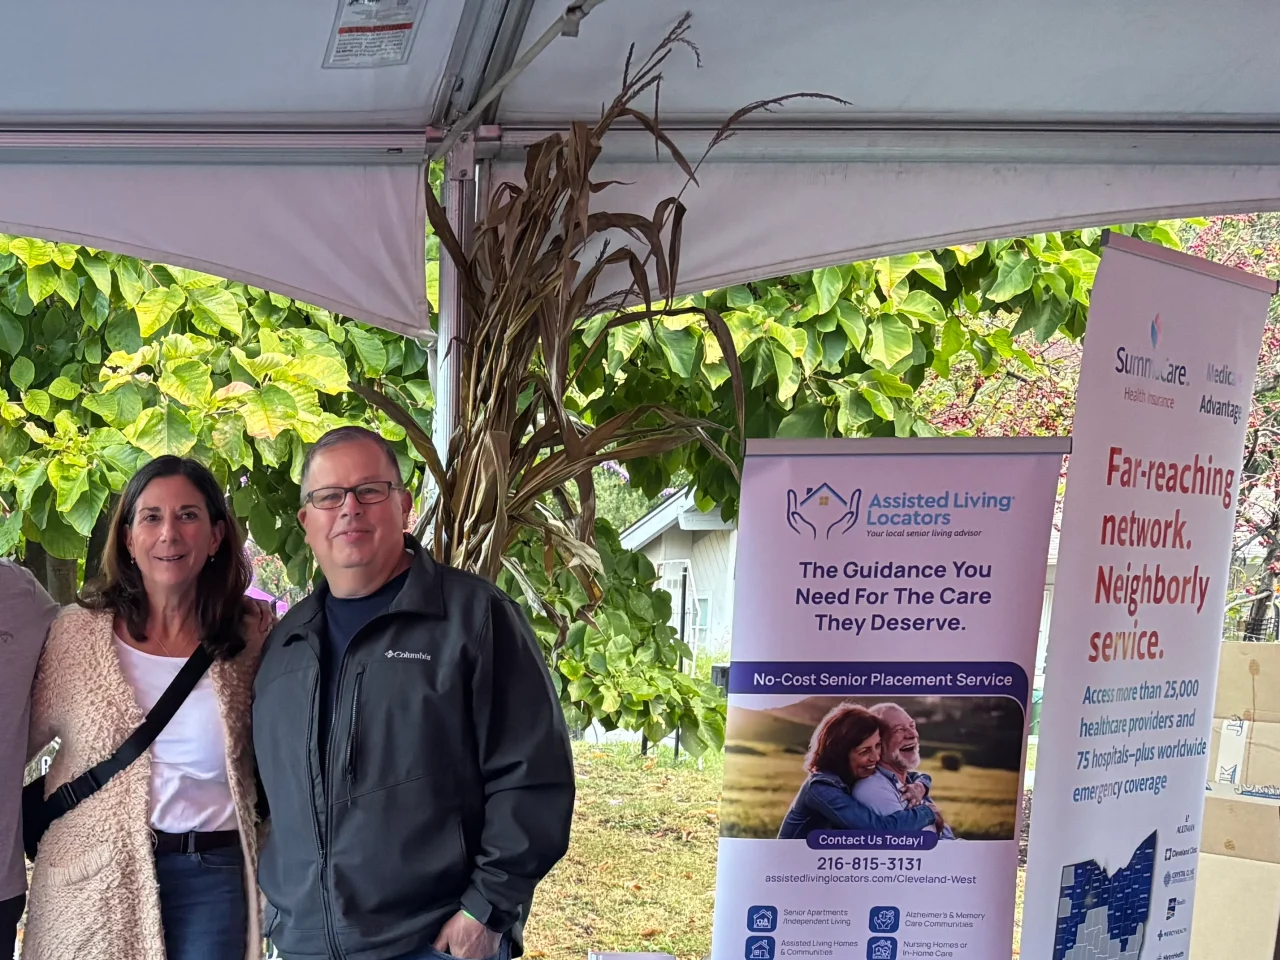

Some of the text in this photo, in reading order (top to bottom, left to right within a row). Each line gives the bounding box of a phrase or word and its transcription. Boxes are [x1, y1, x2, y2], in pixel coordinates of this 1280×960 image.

[1107, 447, 1234, 509] Far-reaching
[868, 491, 1011, 511] Assisted Living
[867, 510, 951, 526] Locators
[866, 529, 982, 539] Your local senior living advisor
[1101, 509, 1192, 550] network.
[799, 561, 992, 579] The Guidance You
[795, 588, 992, 605] Need For The Care
[1095, 562, 1210, 617] Neighborly
[815, 613, 966, 636] They Deserve.
[1088, 619, 1163, 662] service.
[753, 672, 1013, 686] No-Cost Senior Placement Service
[1082, 679, 1199, 704] Access more than 25,000
[1079, 708, 1196, 737] healthcare providers and
[1077, 751, 1090, 770] 75
[1158, 737, 1206, 759] worldwide
[1073, 775, 1167, 804] emergency coverage
[819, 835, 924, 847] Contact Us Today!
[817, 857, 922, 871] 216-815-3131
[765, 873, 977, 885] assistedlivinglocators.com/Cleveland-West
[807, 909, 848, 917] Apartments
[956, 912, 985, 920] Memory
[813, 940, 832, 948] Living
[904, 941, 931, 949] Nursing
